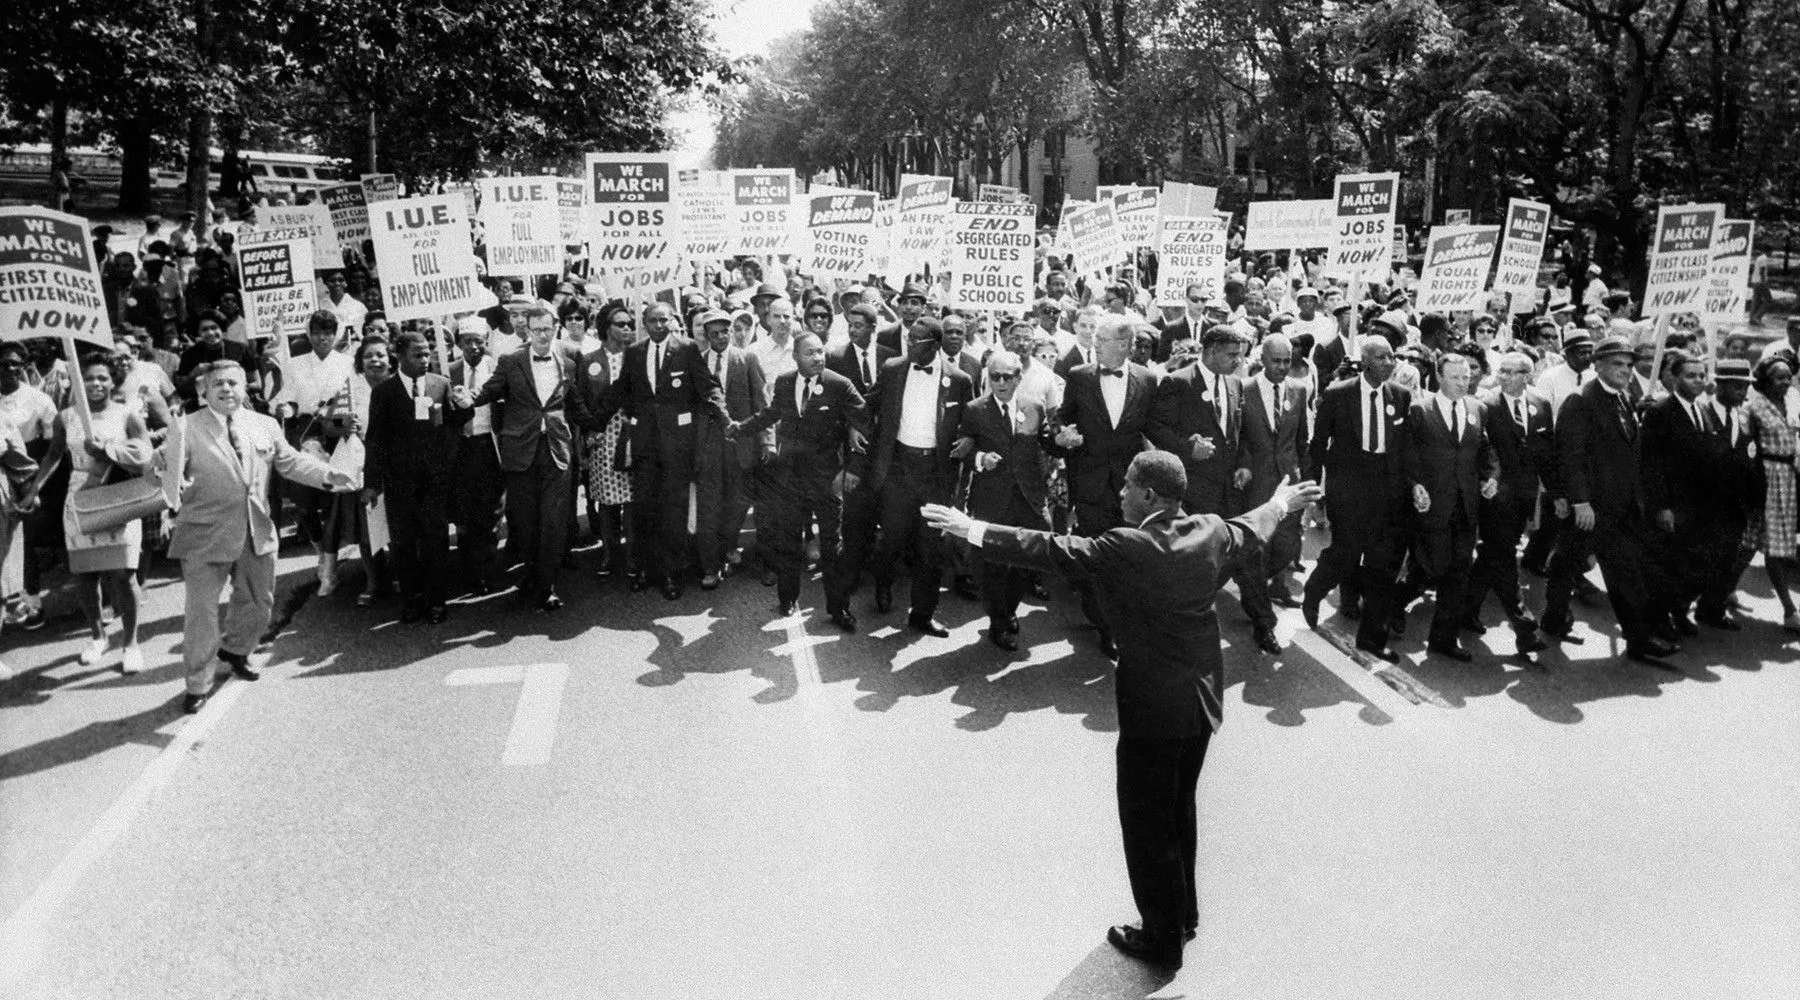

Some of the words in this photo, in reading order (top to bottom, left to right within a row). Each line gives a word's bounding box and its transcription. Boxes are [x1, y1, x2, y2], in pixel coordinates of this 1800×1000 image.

[620, 165, 643, 176] WE
[599, 178, 664, 192] MARCH
[754, 177, 771, 185] WE
[1359, 183, 1375, 193] WE
[495, 185, 548, 202] I.U.E.
[738, 186, 787, 197] MARCH
[831, 195, 856, 209] WE
[1341, 193, 1388, 207] MARCH
[331, 210, 347, 221] IRST
[812, 207, 873, 225] DEMAND
[956, 203, 989, 215] UAW
[270, 214, 314, 225] ASBURY
[386, 205, 456, 231] I.U.E.
[601, 209, 664, 226] JOBS
[740, 210, 787, 223] JOBS
[902, 213, 916, 222] AN
[1681, 214, 1697, 226] WE
[24, 219, 55, 235] WE
[512, 223, 532, 240] FULL
[910, 226, 935, 235] LAW
[968, 218, 1019, 231] END
[1340, 220, 1385, 236] JOBS
[603, 230, 630, 238] FOR
[741, 234, 789, 248] NOW!
[813, 229, 868, 245] VOTING
[956, 232, 1031, 247] SEGREGATED
[1174, 232, 1214, 243] END
[1453, 232, 1479, 249] WE
[1663, 226, 1709, 242] MARCH
[0, 234, 82, 259] MARCH
[413, 238, 437, 249] FOR
[686, 241, 728, 254] NOW!
[901, 237, 940, 249] NOW!
[1163, 244, 1223, 256] SEGREGATED
[30, 252, 63, 263] FOR
[243, 249, 286, 263] BEFORE
[493, 244, 555, 265] EMPLOYMENT
[601, 241, 667, 260] NOW!
[815, 243, 864, 258] RIGHTS
[966, 248, 1019, 261] RULES
[1337, 247, 1385, 264] NOW!
[274, 261, 289, 273] BE
[412, 252, 440, 276] FULL
[811, 256, 864, 273] NOW!
[1170, 256, 1213, 267] RULES
[1503, 255, 1538, 270] SCHOOLS
[1655, 255, 1678, 270] FIRST
[1681, 254, 1708, 270] CLASS
[1435, 267, 1478, 277] EQUAL
[1719, 265, 1738, 274] END
[0, 269, 46, 287] FIRST
[53, 271, 96, 294] CLASS
[244, 277, 252, 288] A
[623, 264, 681, 290] NOW!
[962, 273, 1023, 288] PUBLIC
[1651, 269, 1707, 285] CITIZENSHIP
[390, 275, 471, 308] EMPLOYMENT
[1431, 280, 1477, 290] RIGHTS
[0, 286, 101, 310] CITIZENSHIP
[288, 289, 303, 300] BE
[959, 289, 1024, 304] SCHOOLS
[1164, 289, 1216, 301] SCHS
[1427, 291, 1476, 306] NOW!
[1651, 287, 1700, 307] NOW!
[298, 301, 310, 312] IN
[18, 309, 99, 335] NOW!
